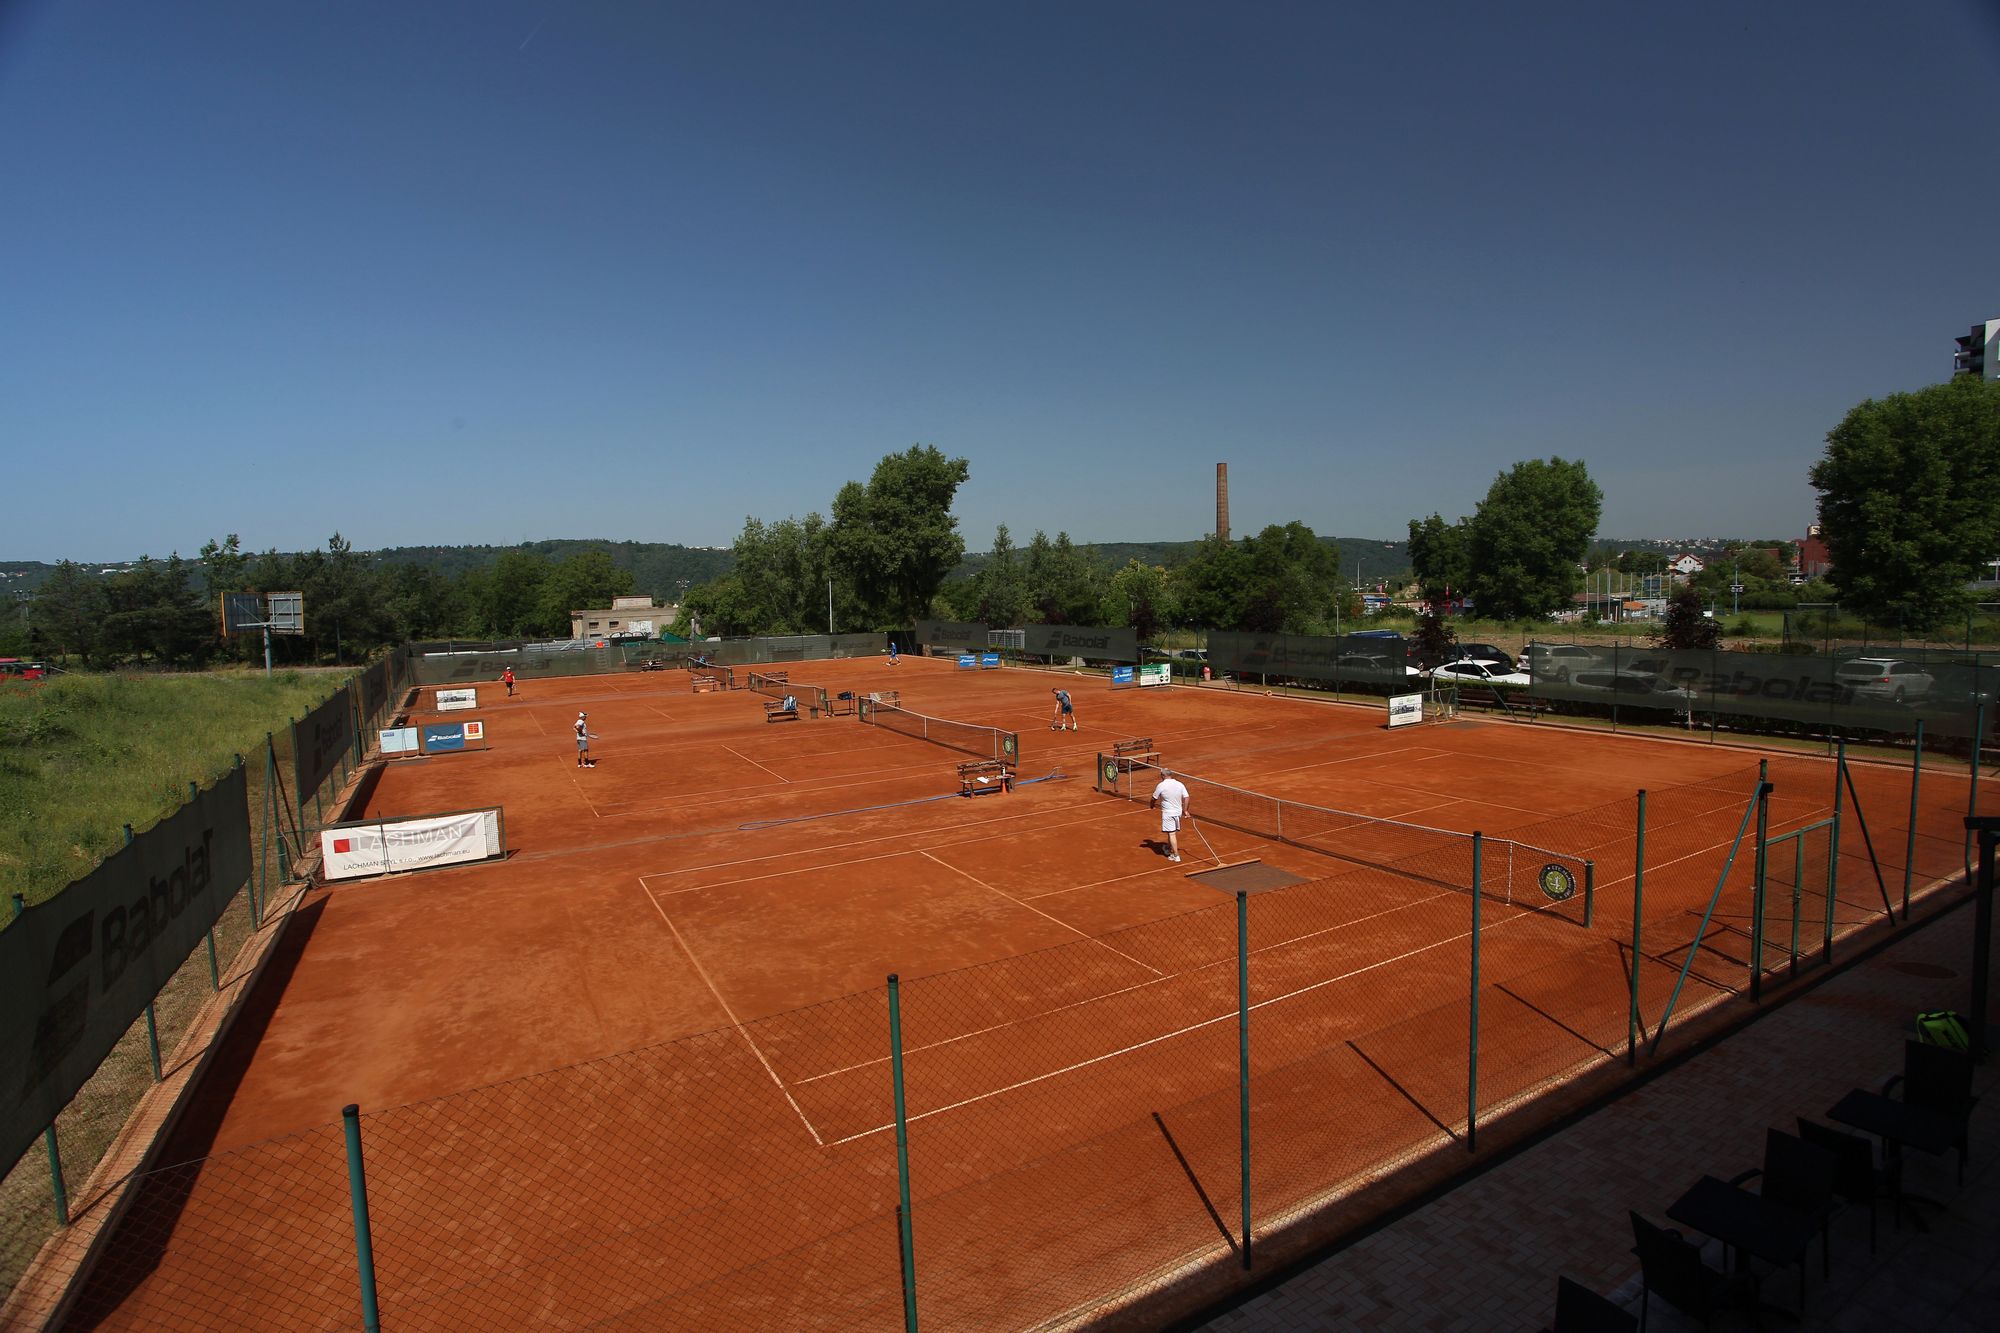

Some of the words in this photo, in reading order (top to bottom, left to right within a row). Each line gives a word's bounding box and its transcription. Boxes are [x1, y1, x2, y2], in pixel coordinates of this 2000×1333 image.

[1063, 634, 1112, 649] Babolat
[357, 825, 463, 851] LACHMAN
[343, 860, 379, 871] LACHMAN
[102, 828, 213, 995] Babolat
